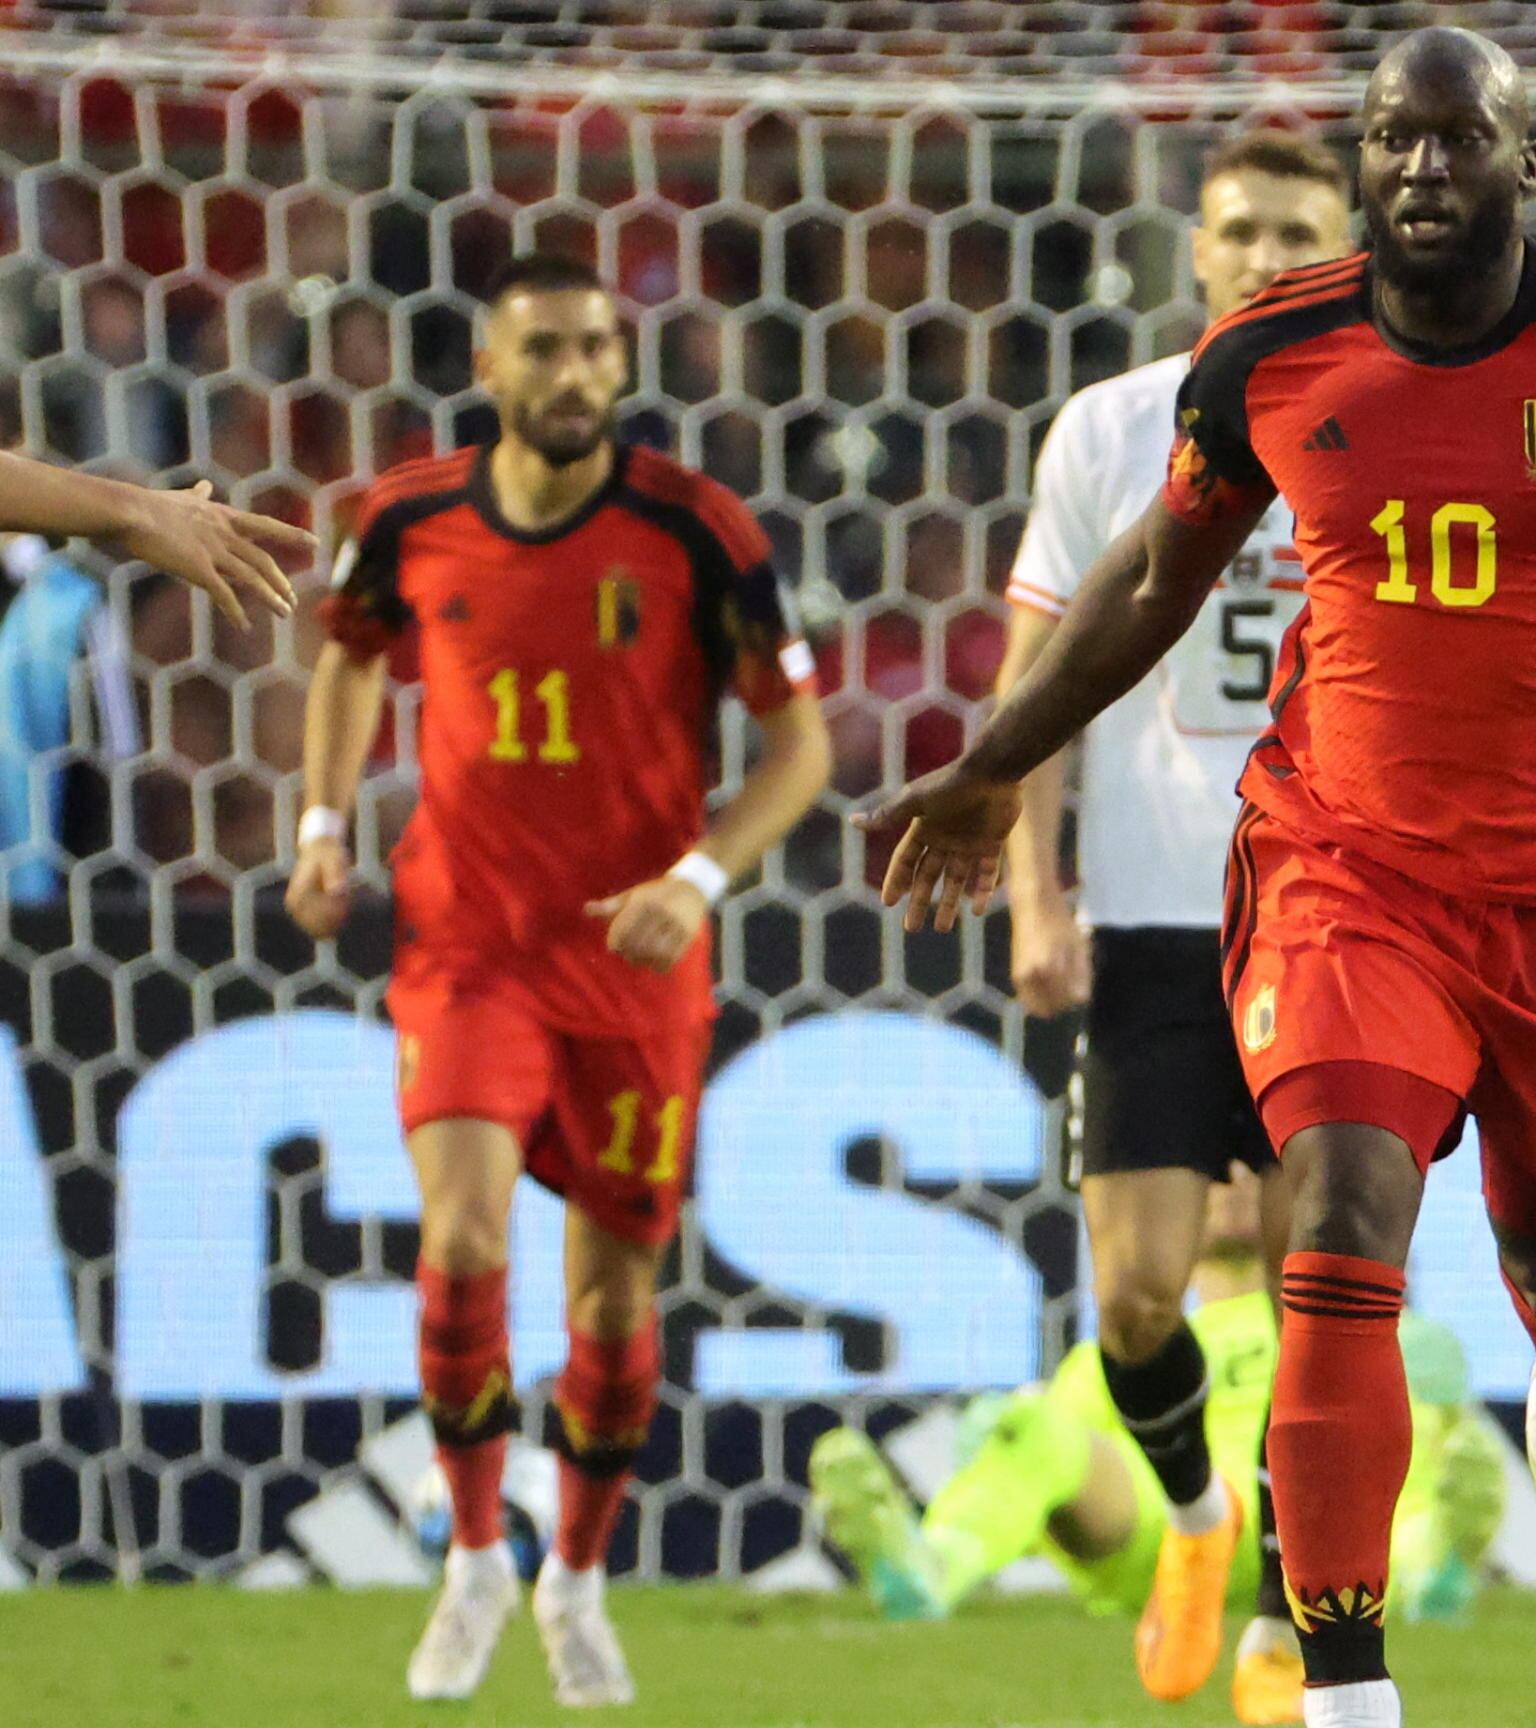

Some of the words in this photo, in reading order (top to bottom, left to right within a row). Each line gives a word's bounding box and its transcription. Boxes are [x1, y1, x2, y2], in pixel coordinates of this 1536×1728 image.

[1369, 500, 1497, 607] 10
[1222, 602, 1275, 702] 5
[486, 668, 580, 763] 11
[597, 1090, 685, 1182] 11
